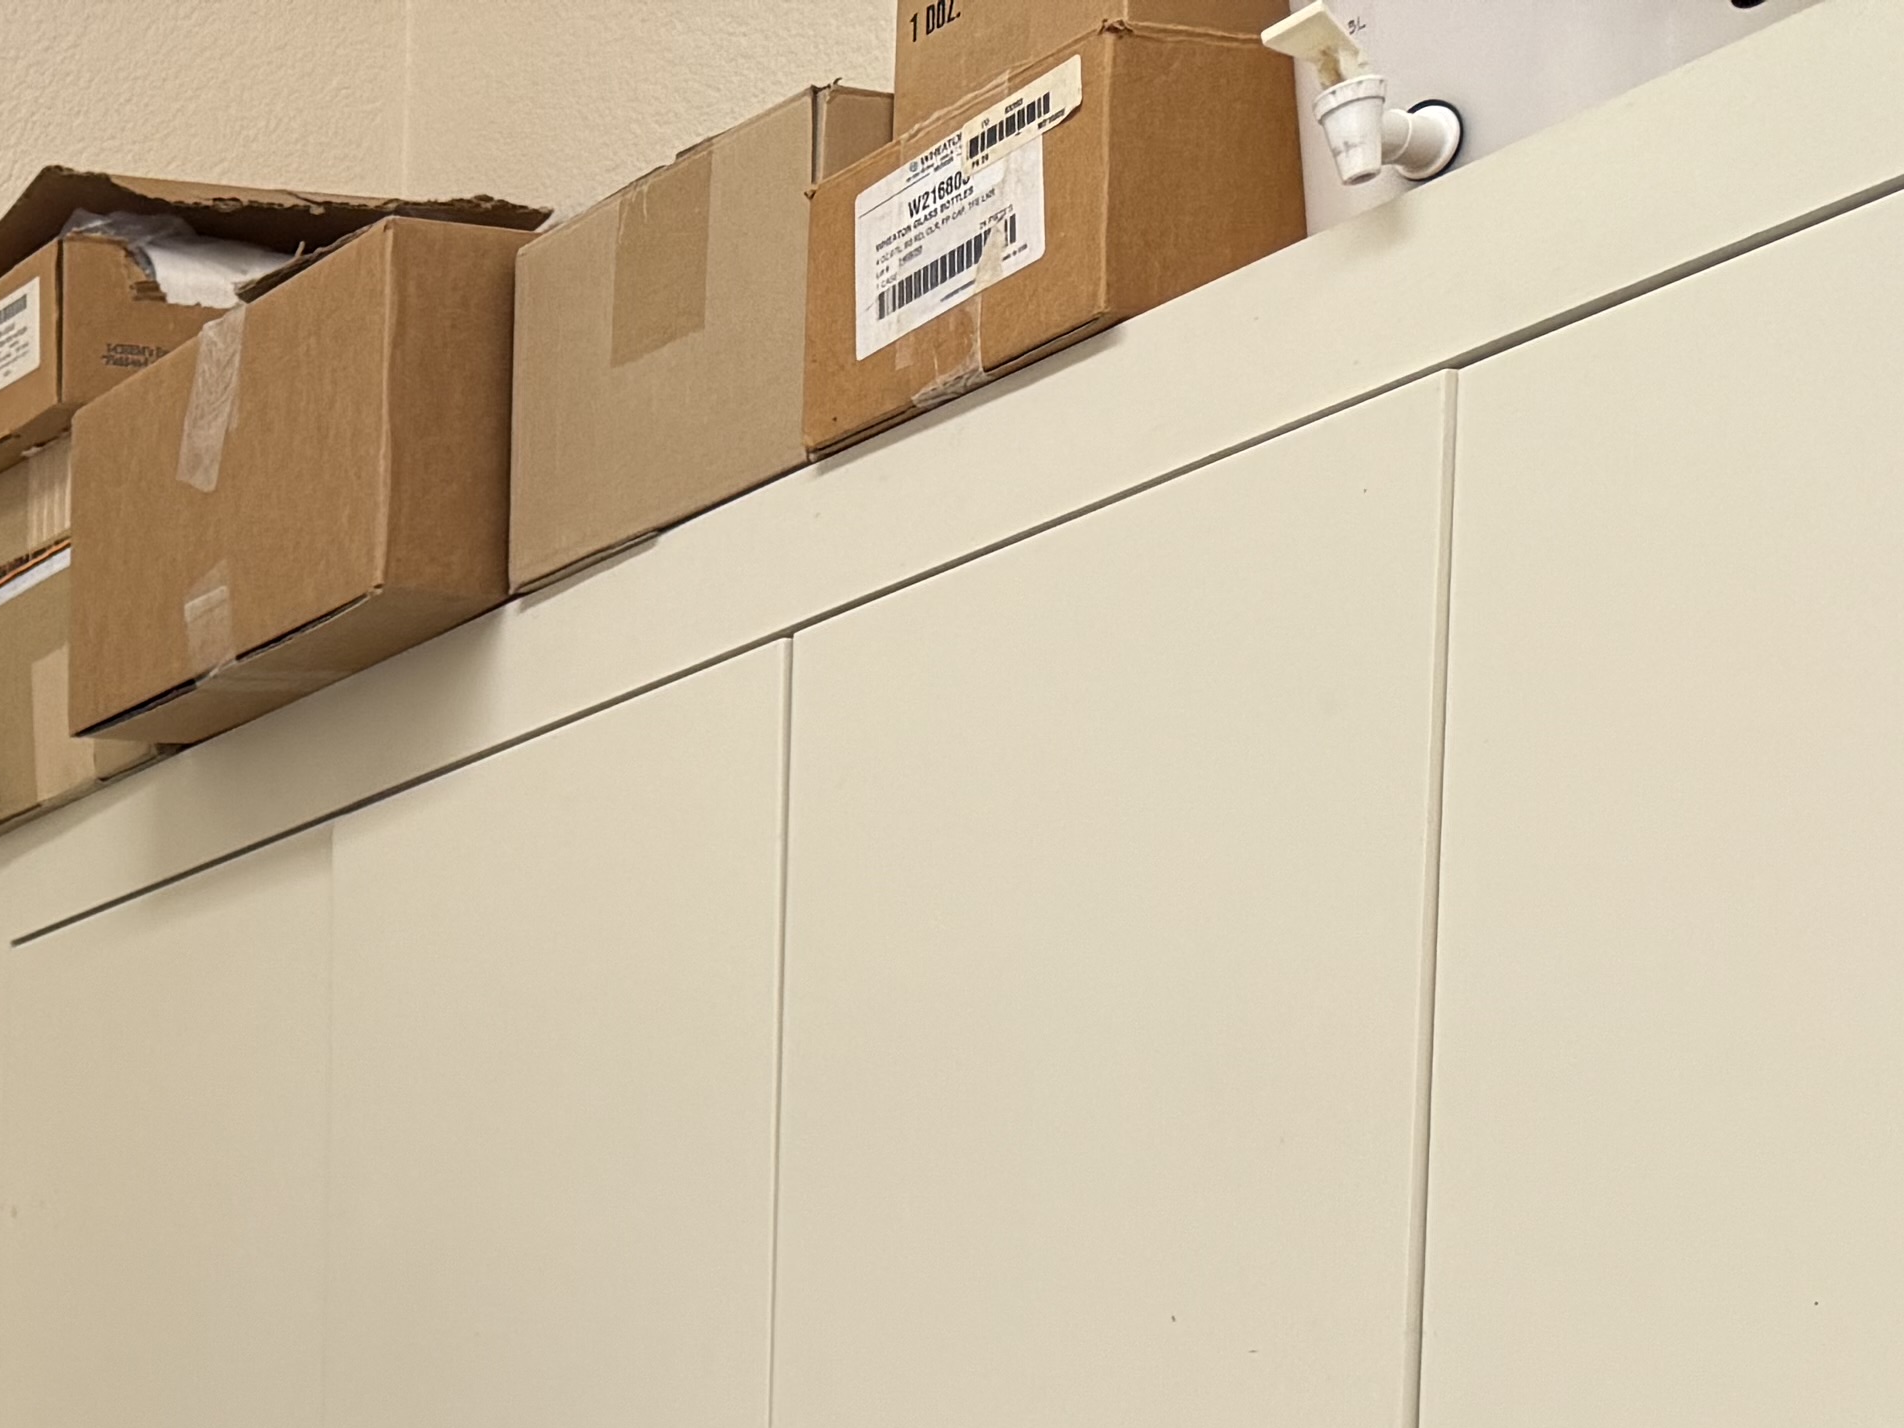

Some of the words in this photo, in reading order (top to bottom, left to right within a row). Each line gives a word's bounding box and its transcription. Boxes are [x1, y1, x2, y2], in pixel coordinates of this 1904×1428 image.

[910, 13, 917, 42] 1
[926, 0, 961, 35] DOZ.
[920, 133, 962, 166] WHEATO
[913, 207, 938, 230] GLASS
[940, 184, 973, 214] BOTTLES
